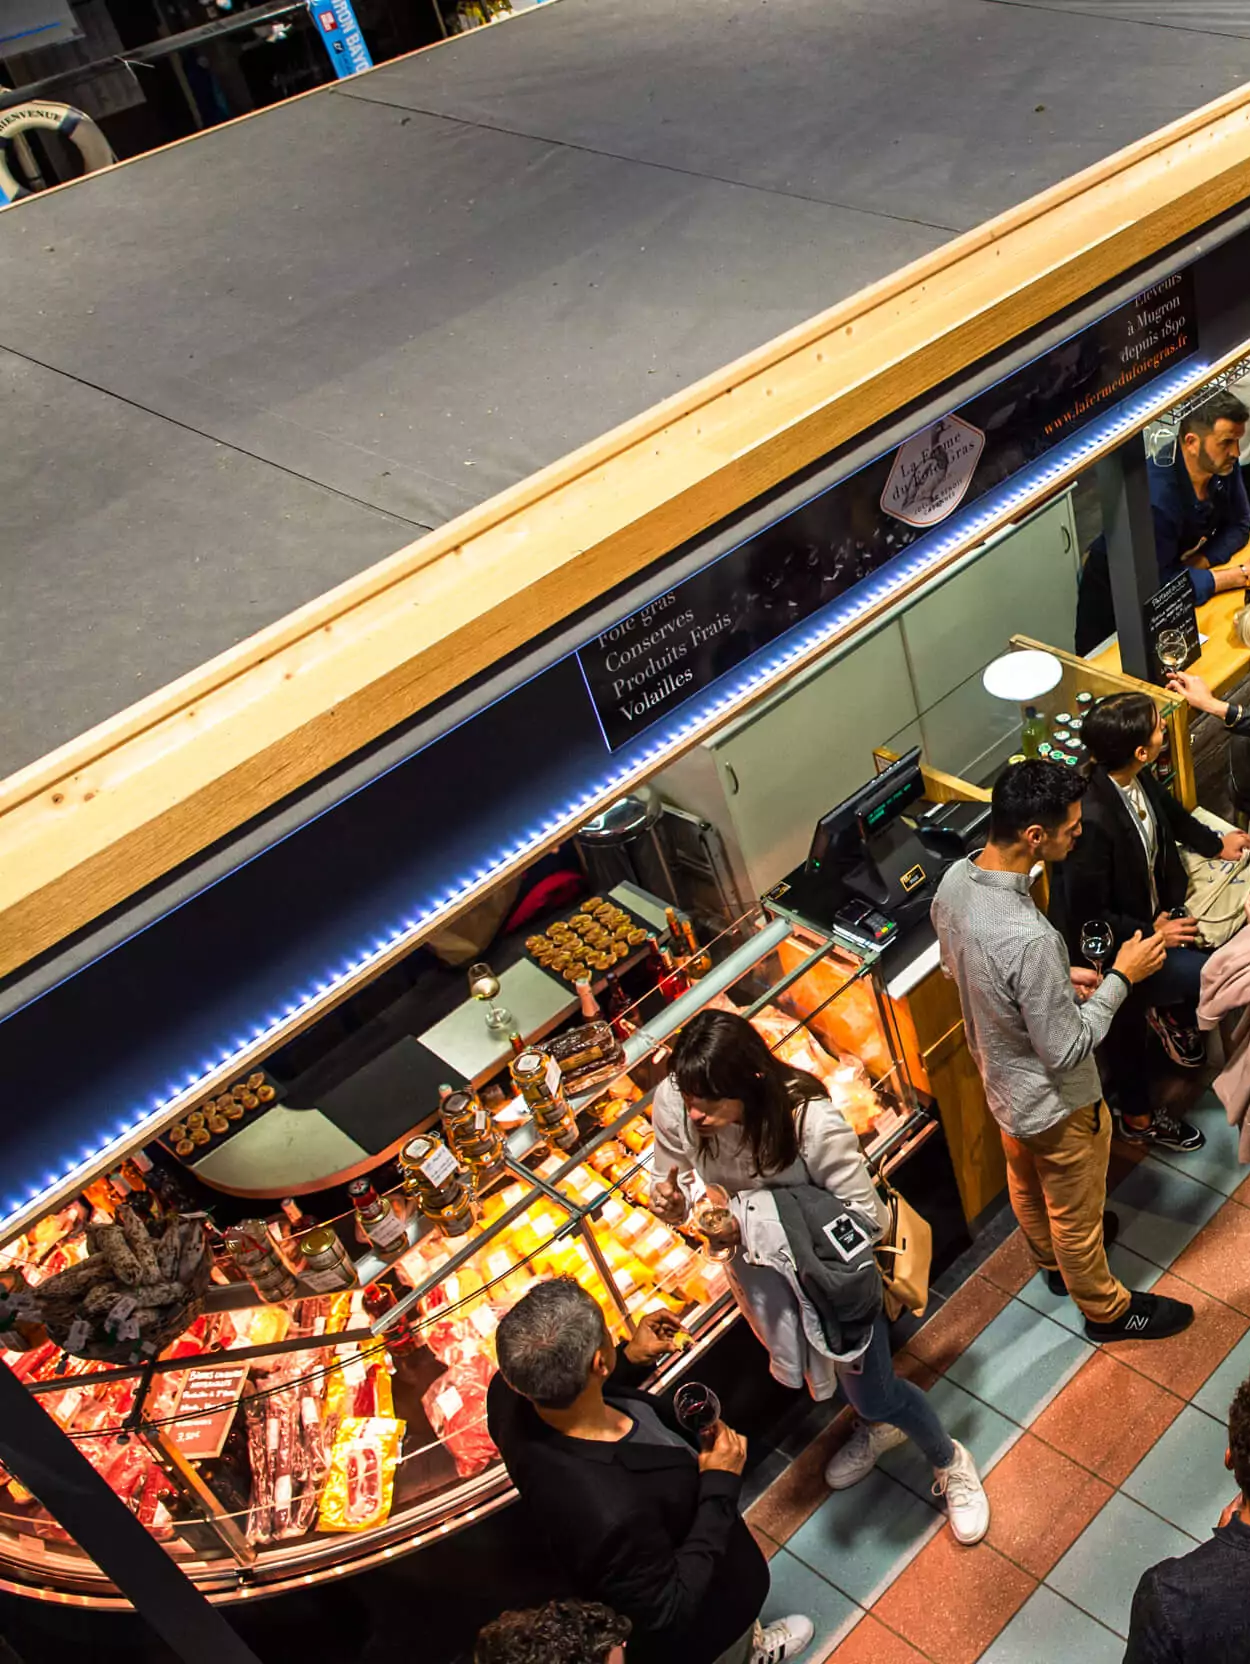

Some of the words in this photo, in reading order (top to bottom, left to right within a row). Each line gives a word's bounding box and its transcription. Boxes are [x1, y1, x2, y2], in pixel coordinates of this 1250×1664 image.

[1121, 330, 1160, 363] depuis
[1161, 315, 1186, 338] 1890
[1127, 320, 1136, 336] à
[1136, 296, 1180, 330] Mugron
[1044, 333, 1188, 435] www.lafermedufoiegras.fr
[892, 482, 909, 501] du
[900, 462, 917, 479] La
[640, 590, 677, 627] gras
[605, 608, 695, 673] Conserves
[612, 643, 688, 700] Produits
[689, 613, 733, 648] Frais
[619, 667, 694, 722] Volailles
